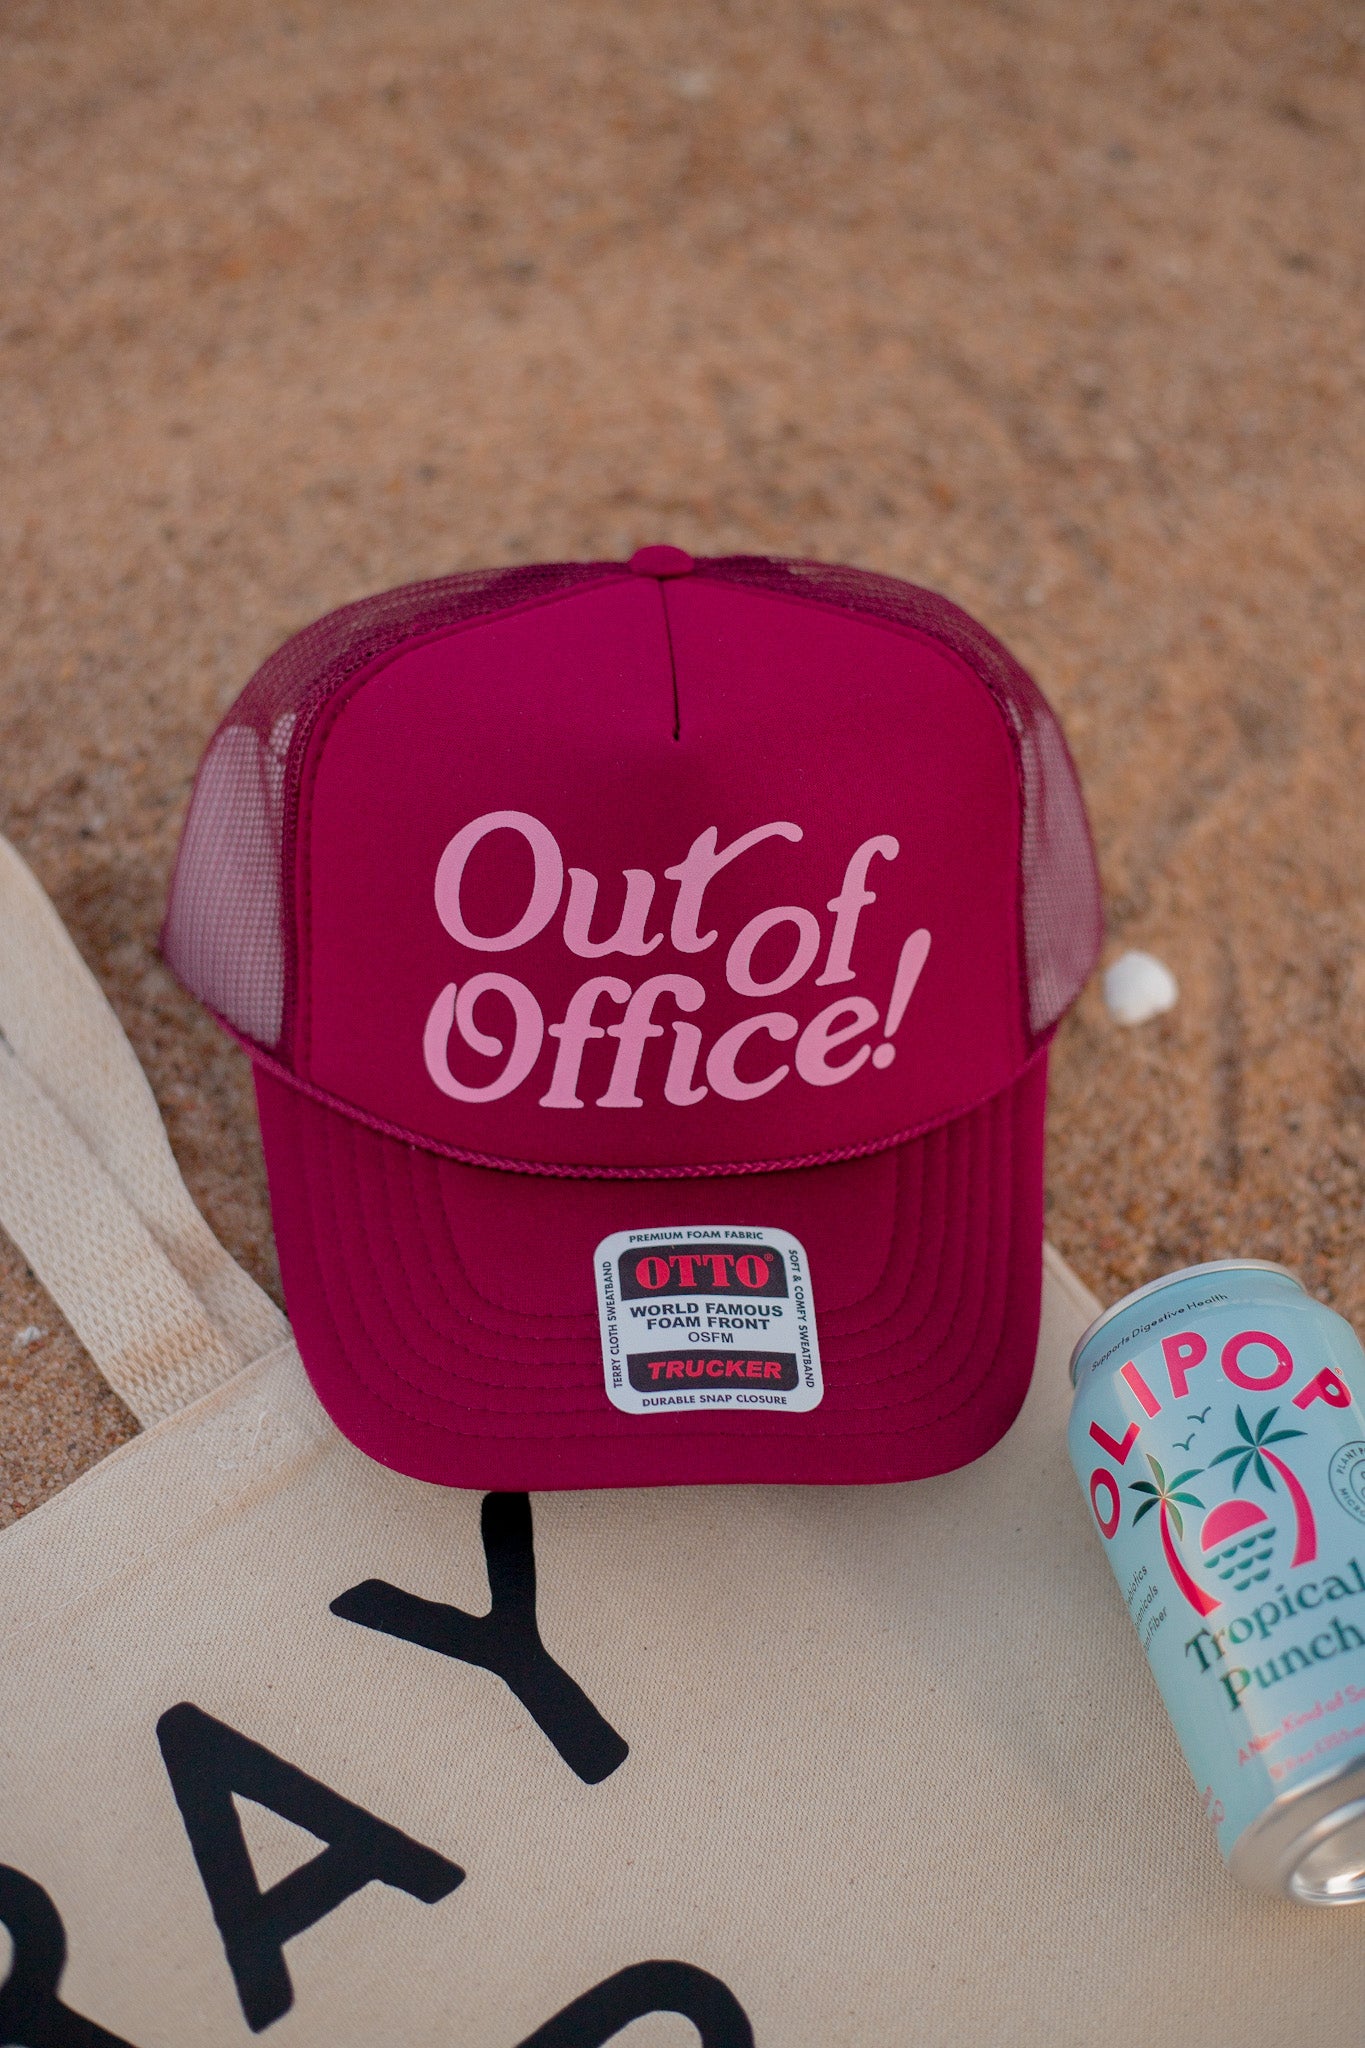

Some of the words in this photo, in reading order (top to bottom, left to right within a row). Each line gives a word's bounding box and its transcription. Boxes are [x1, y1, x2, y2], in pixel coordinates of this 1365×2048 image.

[434, 810, 803, 958] Out
[726, 834, 900, 997] of
[423, 928, 932, 1109] Office!
[629, 1231, 683, 1243] PREMIUM
[687, 1230, 721, 1239] FOAM
[724, 1230, 764, 1240] FABRIC
[789, 1249, 800, 1273] SOFT
[602, 1260, 617, 1321] SWEATBAND
[793, 1274, 802, 1283] &
[630, 1302, 699, 1318] WORLD
[705, 1302, 784, 1317] FAMOUS
[794, 1285, 807, 1323] COMFY
[646, 1316, 701, 1330] FOAM
[707, 1316, 771, 1330] FRONT
[688, 1331, 734, 1343] OSFM
[1091, 1337, 1131, 1372] Supports
[1131, 1308, 1185, 1339] Digestive
[1187, 1293, 1229, 1312] Health
[609, 1324, 620, 1355] CLOTH
[647, 1359, 782, 1380] TRUCKER
[798, 1325, 815, 1388] SWEATBAND
[613, 1359, 623, 1389] TERRY
[642, 1395, 696, 1407] DURABLE
[699, 1394, 732, 1404] SNAP
[736, 1394, 787, 1405] CLOSURE
[1089, 1330, 1353, 1540] OLIPOP
[1184, 1556, 1365, 1674] Tropical
[1220, 1616, 1365, 1711] Punch
